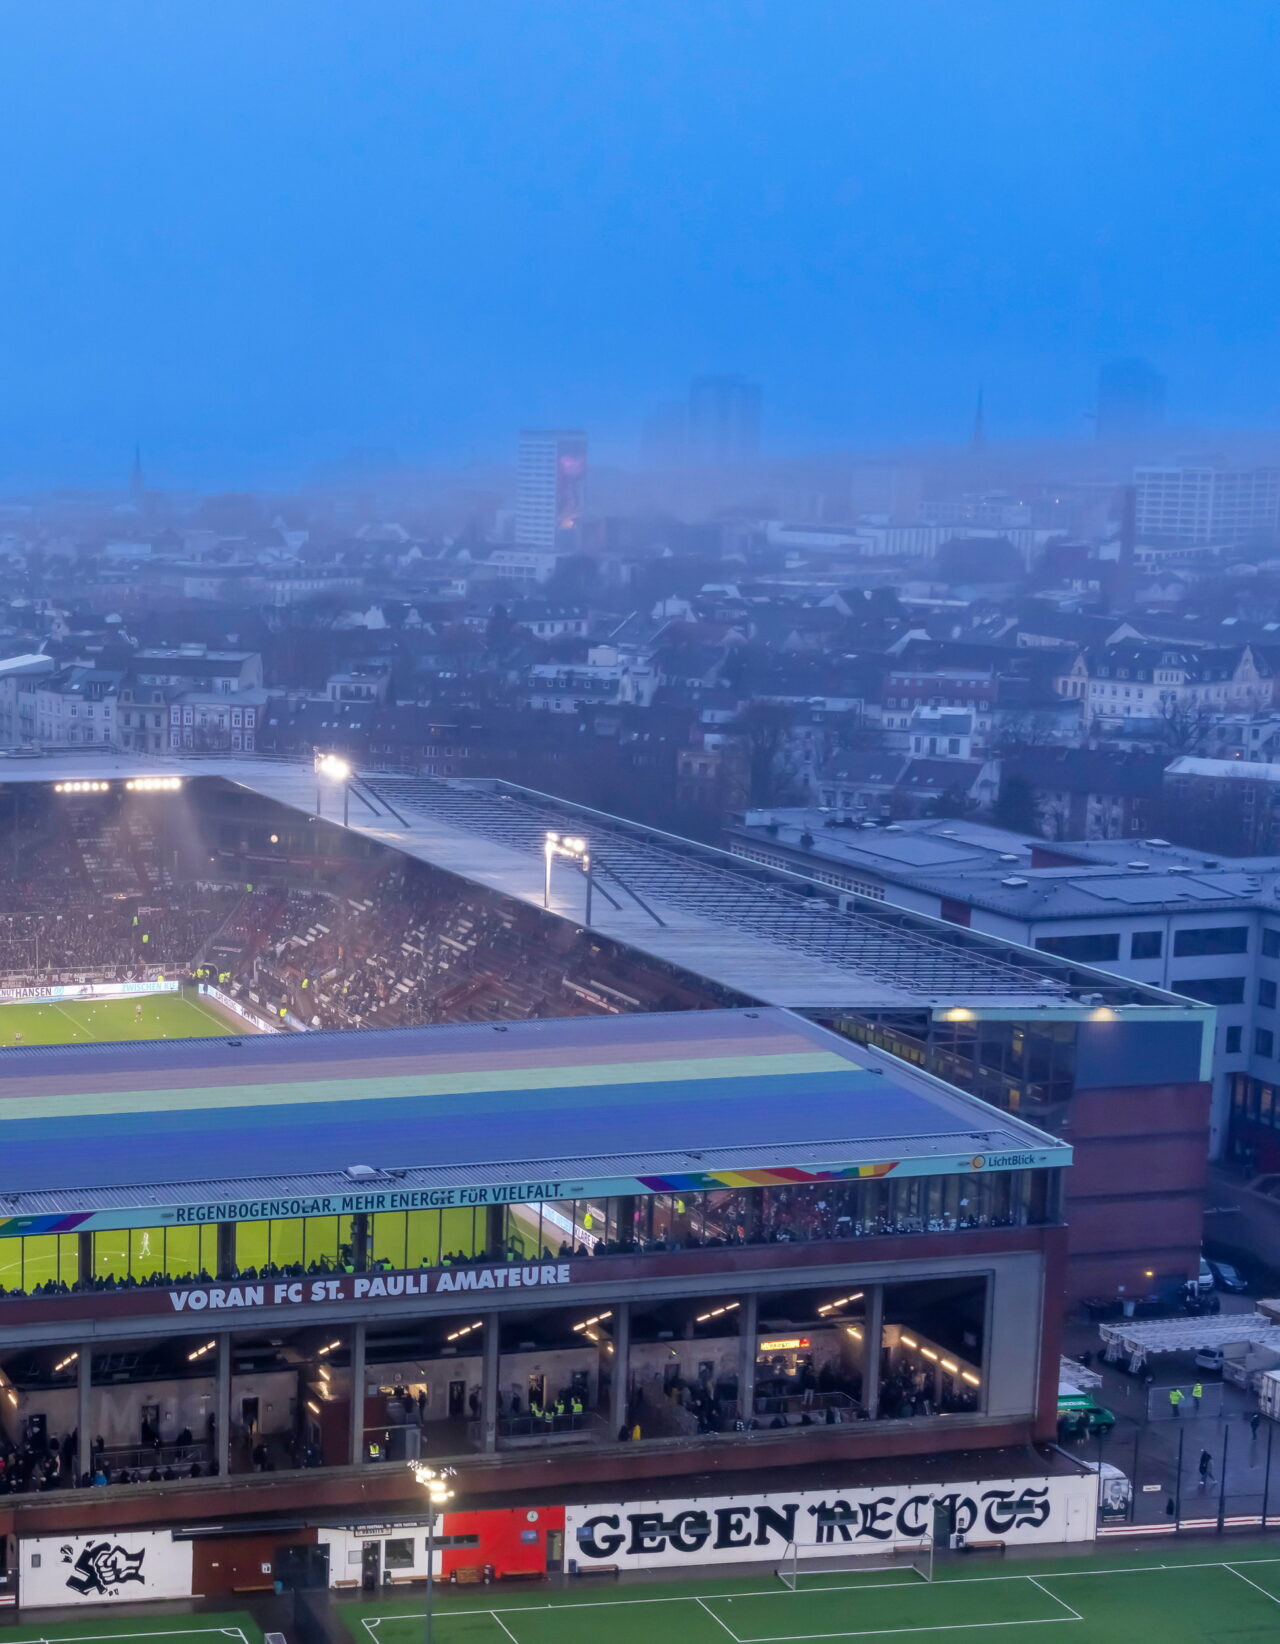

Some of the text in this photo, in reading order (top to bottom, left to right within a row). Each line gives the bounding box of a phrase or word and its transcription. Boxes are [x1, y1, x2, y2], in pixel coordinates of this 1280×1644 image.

[15, 987, 52, 998] HANSEN
[988, 1154, 1035, 1167] LichtBlick
[176, 1183, 564, 1222] REGENBOGENSOLAR. MEHR ENERGIE FÜR VIELFALT.
[169, 1263, 570, 1311] VORAN FC ST. PAULI AMATEURE
[579, 1486, 1050, 1559] GEGEN RECHTS
